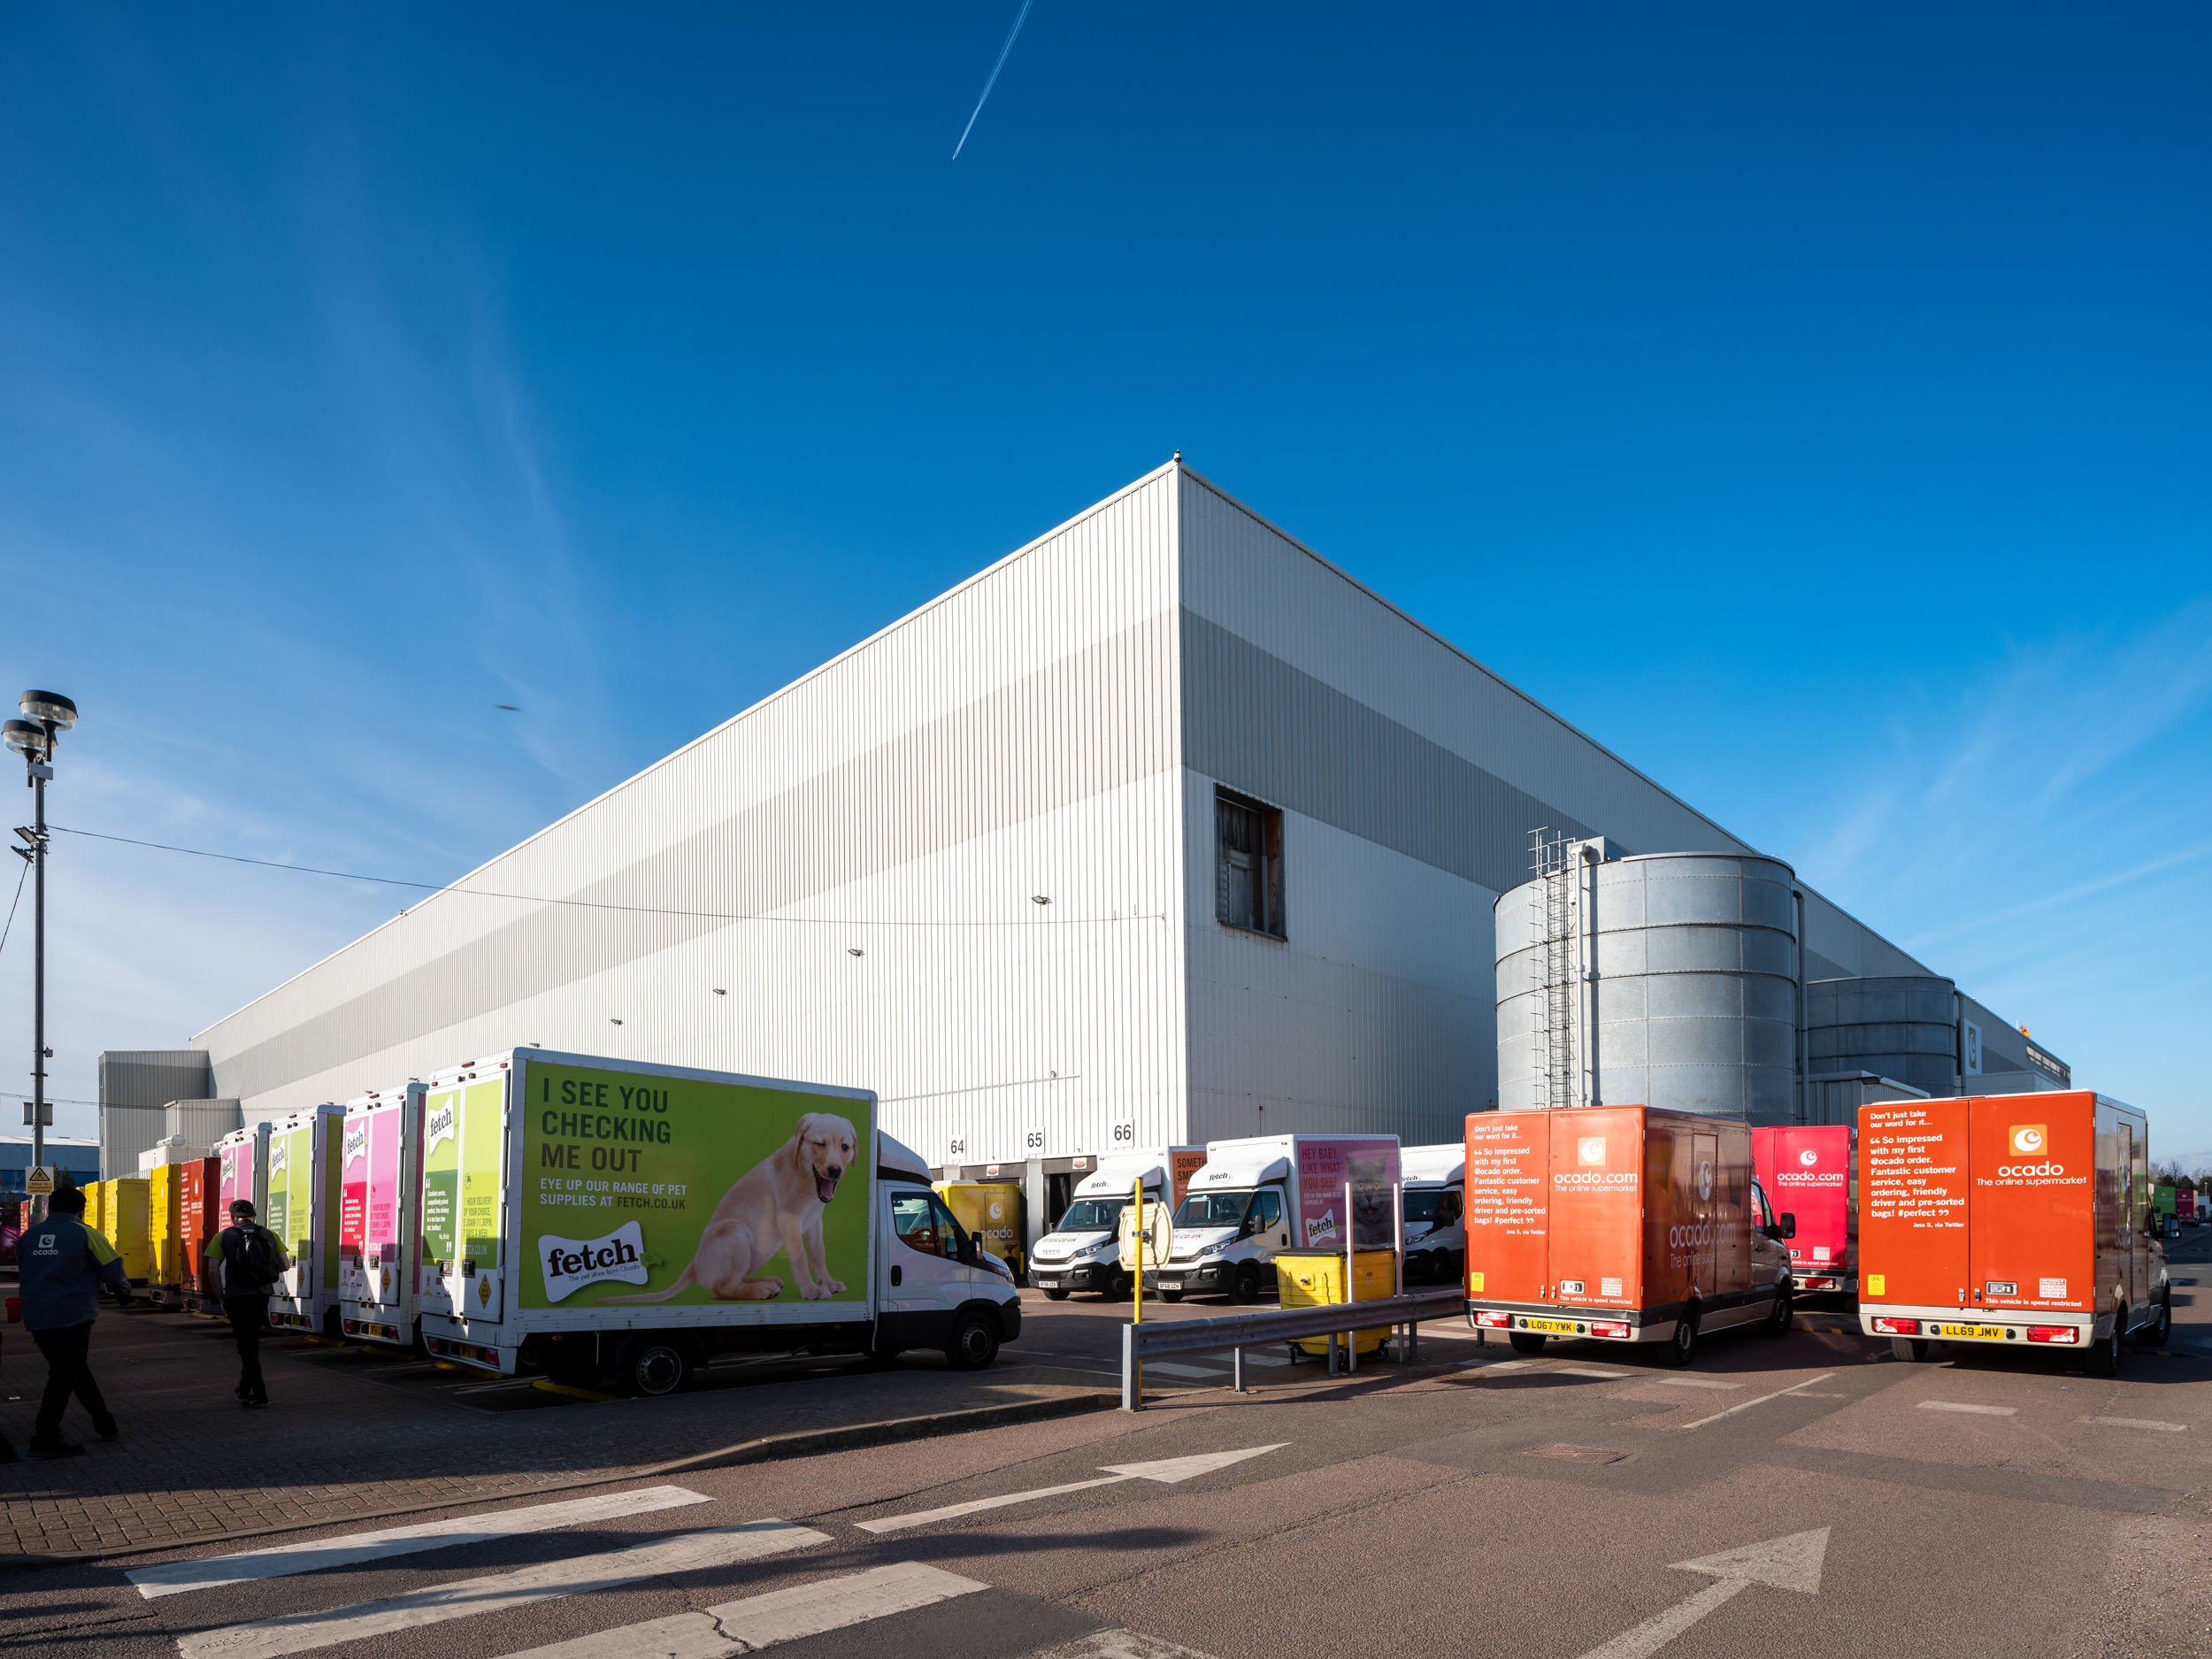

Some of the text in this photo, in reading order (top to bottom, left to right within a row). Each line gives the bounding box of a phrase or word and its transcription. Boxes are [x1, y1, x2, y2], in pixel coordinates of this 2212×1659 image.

[543, 1078, 668, 1113] I SEE YOU
[1893, 1111, 1907, 1120] just
[430, 1108, 452, 1137] fetch
[541, 1110, 671, 1144] CHECKING
[1114, 1125, 1131, 1141] 66
[1896, 1133, 1942, 1144] impressed
[347, 1131, 364, 1154] fetch
[950, 1140, 964, 1154] 64
[1027, 1133, 1042, 1148] 65
[272, 1148, 285, 1168] fetch
[541, 1143, 641, 1172] ME OUT
[1302, 1148, 1339, 1160] HEY BABY,
[1494, 1147, 1530, 1156] impressed
[1302, 1162, 1340, 1174] LIKE WHAT
[1870, 1167, 1911, 1176] Fantastic
[1997, 1161, 2064, 1177] ocado
[1209, 1172, 1227, 1181] fetch
[1554, 1169, 1638, 1184] ocado.com
[1777, 1171, 1844, 1181] ocado.com
[1870, 1178, 1926, 1187] service, easy
[2025, 1176, 2086, 1187] supermarket
[541, 1178, 687, 1195] EYE UP OUR RANGE OF PET
[1303, 1177, 1336, 1190] YOU SEE?
[1870, 1187, 1947, 1197] ordering, friendly
[540, 1194, 686, 1210] SUPPLIES AT FETCH.CO.UK
[1918, 1198, 1964, 1208] pre-sorted
[1510, 1207, 1546, 1216] pre-sorted
[1871, 1209, 1936, 1218] bags! #perfect
[982, 1225, 1013, 1239] ocado
[1309, 1217, 1333, 1237] fetch
[1670, 1218, 1736, 1248] ocado.com
[548, 1239, 639, 1278] fetch
[1671, 1253, 1682, 1268] The
[619, 1263, 640, 1272] Ocado
[1555, 1322, 1571, 1331] YWK
[1947, 1326, 1999, 1337] LL69 JMV
